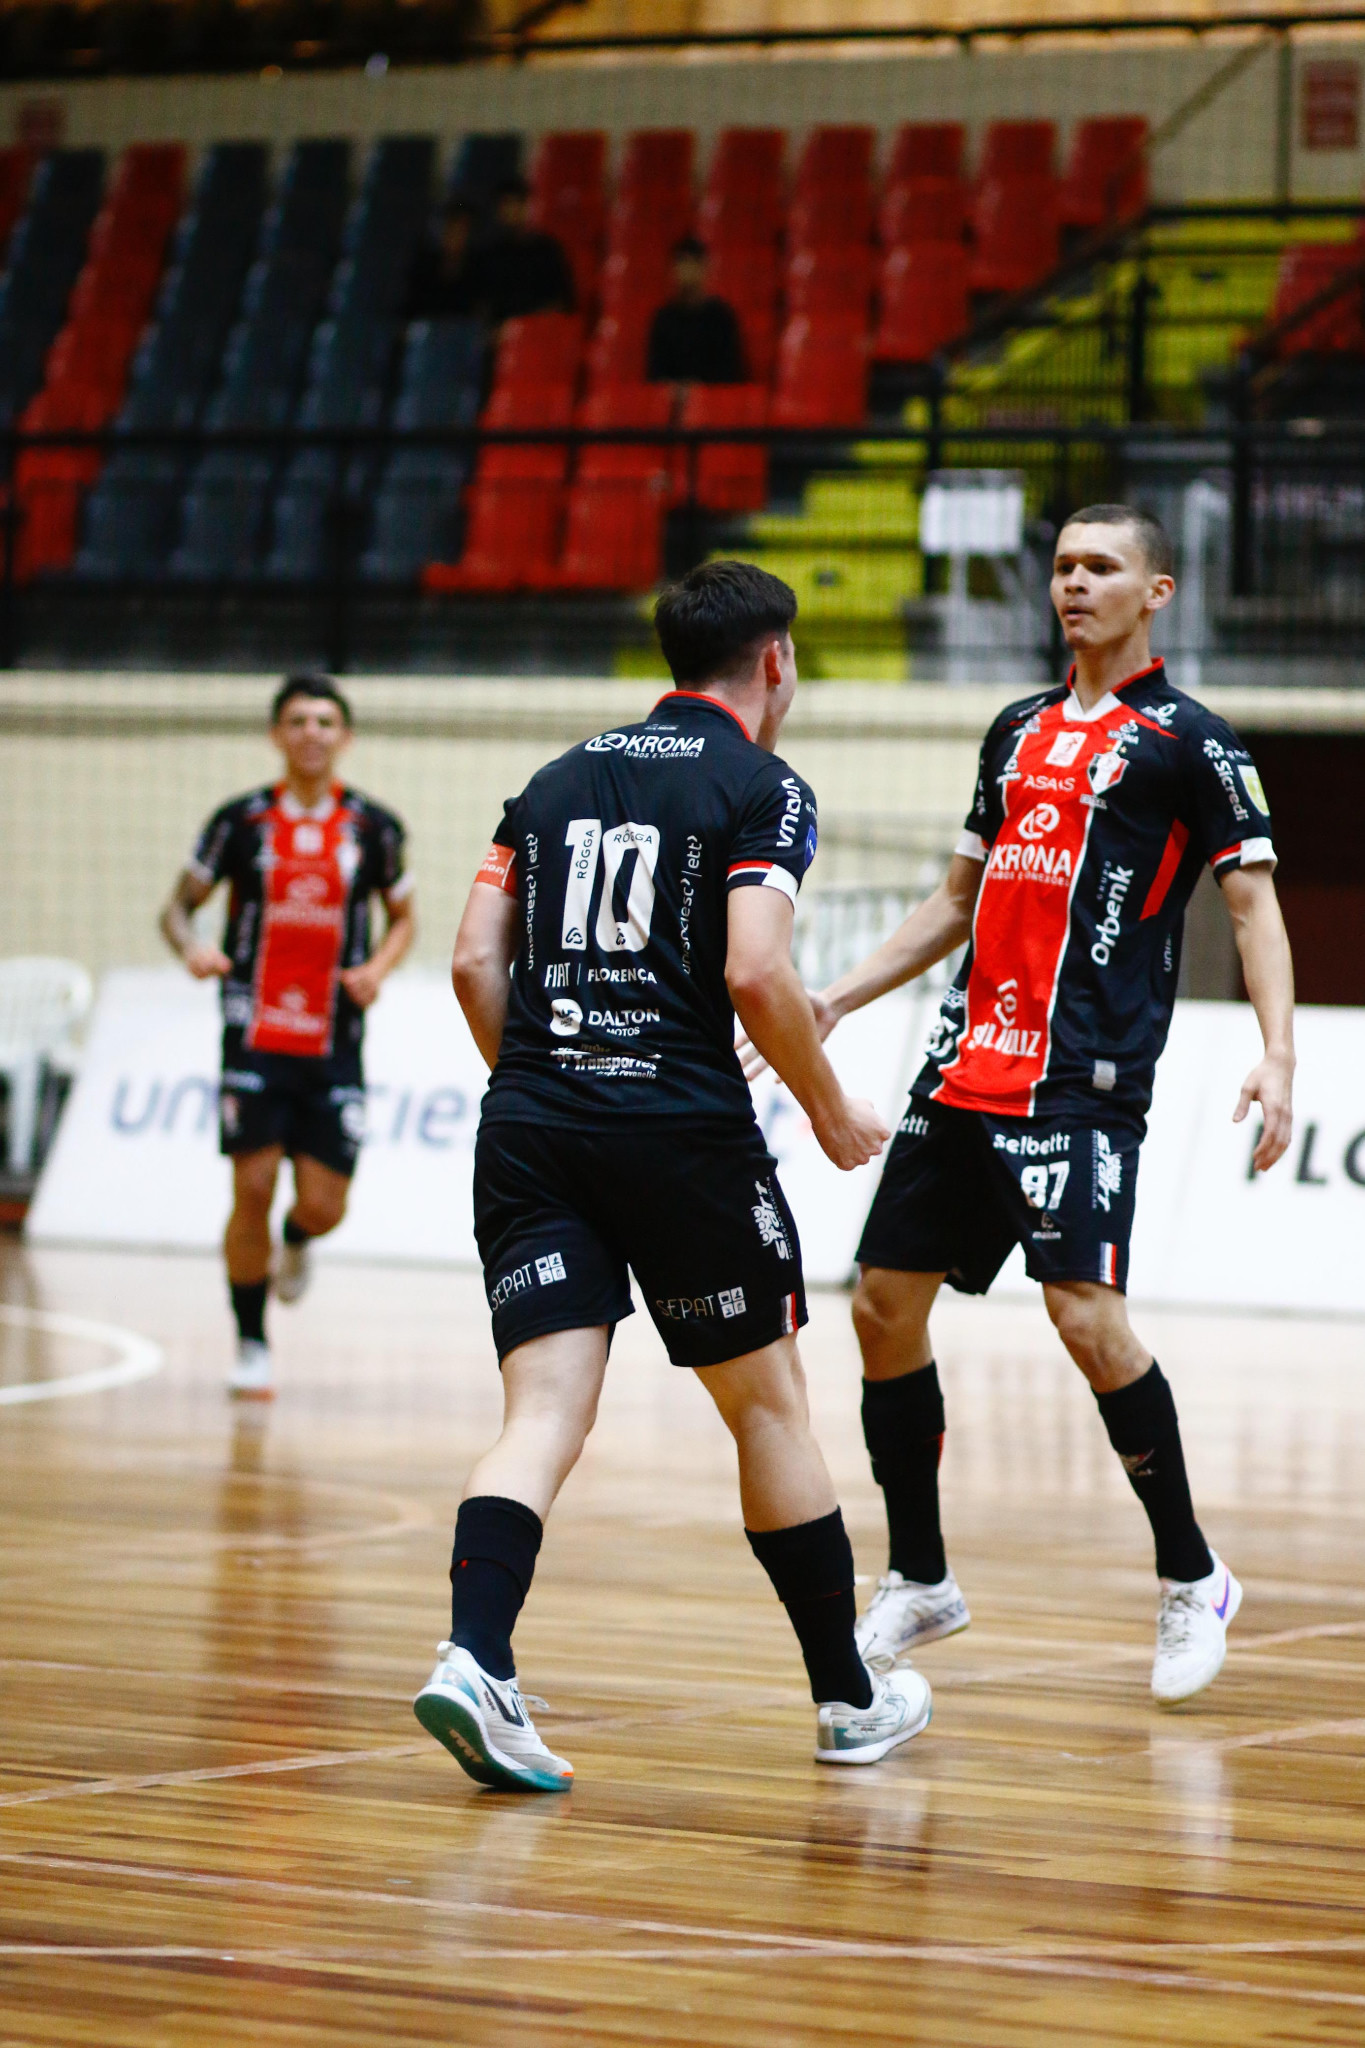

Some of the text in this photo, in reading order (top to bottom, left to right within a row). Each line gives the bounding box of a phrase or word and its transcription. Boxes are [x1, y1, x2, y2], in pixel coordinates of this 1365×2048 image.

[626, 734, 706, 753] KRONA
[1213, 760, 1250, 821] Sicredi
[576, 829, 596, 879] RÔGGA
[989, 843, 1071, 878] KRONA
[561, 818, 661, 953] 10
[1090, 865, 1134, 966] Orbenk
[544, 962, 571, 988] FIAT
[588, 967, 658, 985] FLORENÇA
[588, 1008, 661, 1027] DALTON
[606, 1027, 640, 1037] MOTOS
[490, 1263, 533, 1311] SEPAT
[656, 1294, 715, 1320] SEPAT
